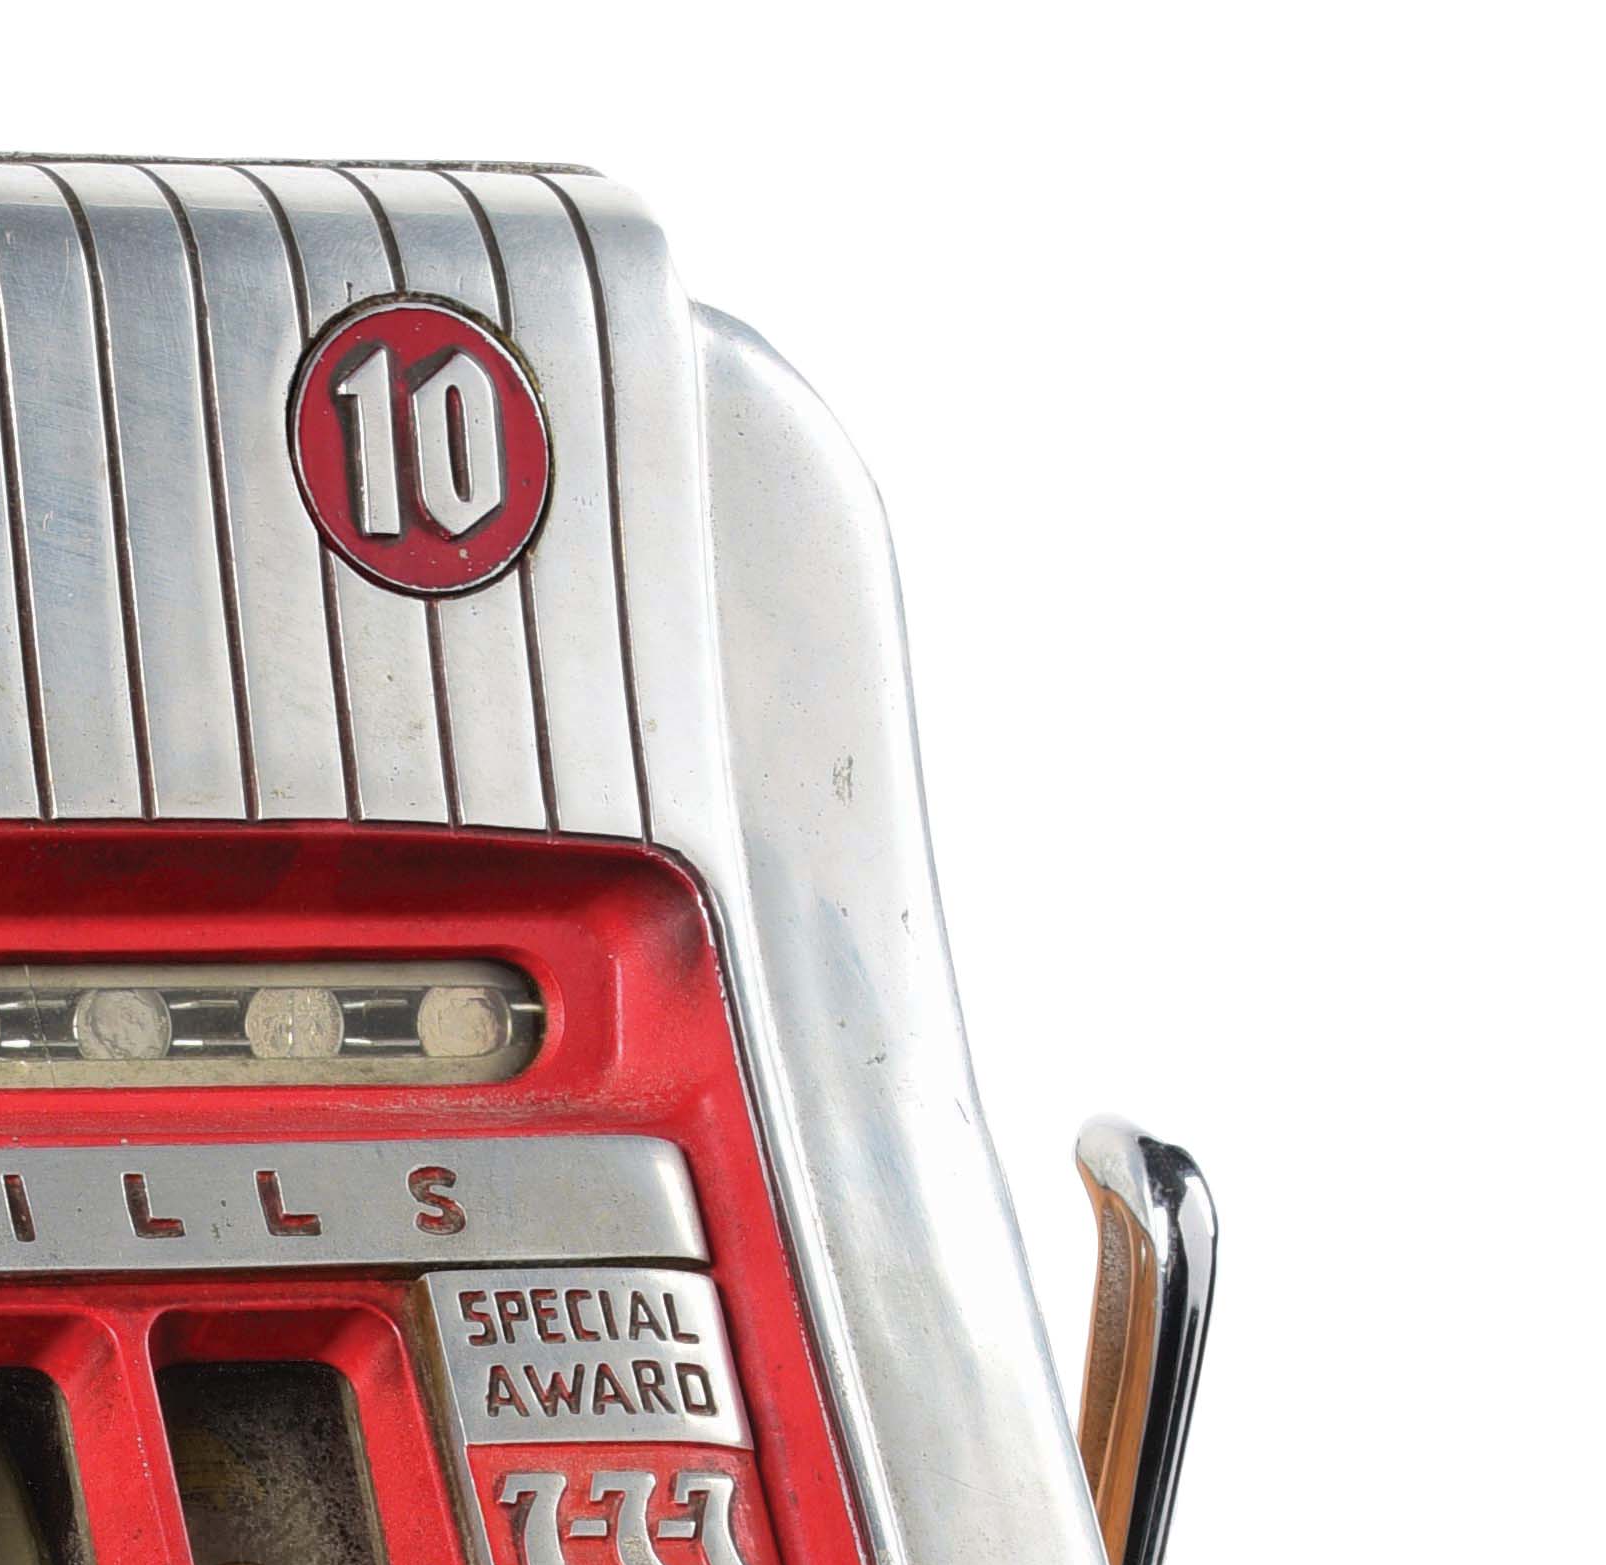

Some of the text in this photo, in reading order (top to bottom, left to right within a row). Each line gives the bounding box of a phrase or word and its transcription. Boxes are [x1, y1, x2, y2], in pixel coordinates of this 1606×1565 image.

[335, 349, 502, 535] 10
[458, 1288, 699, 1346] SPECIAL
[486, 1360, 718, 1417] AWARD
